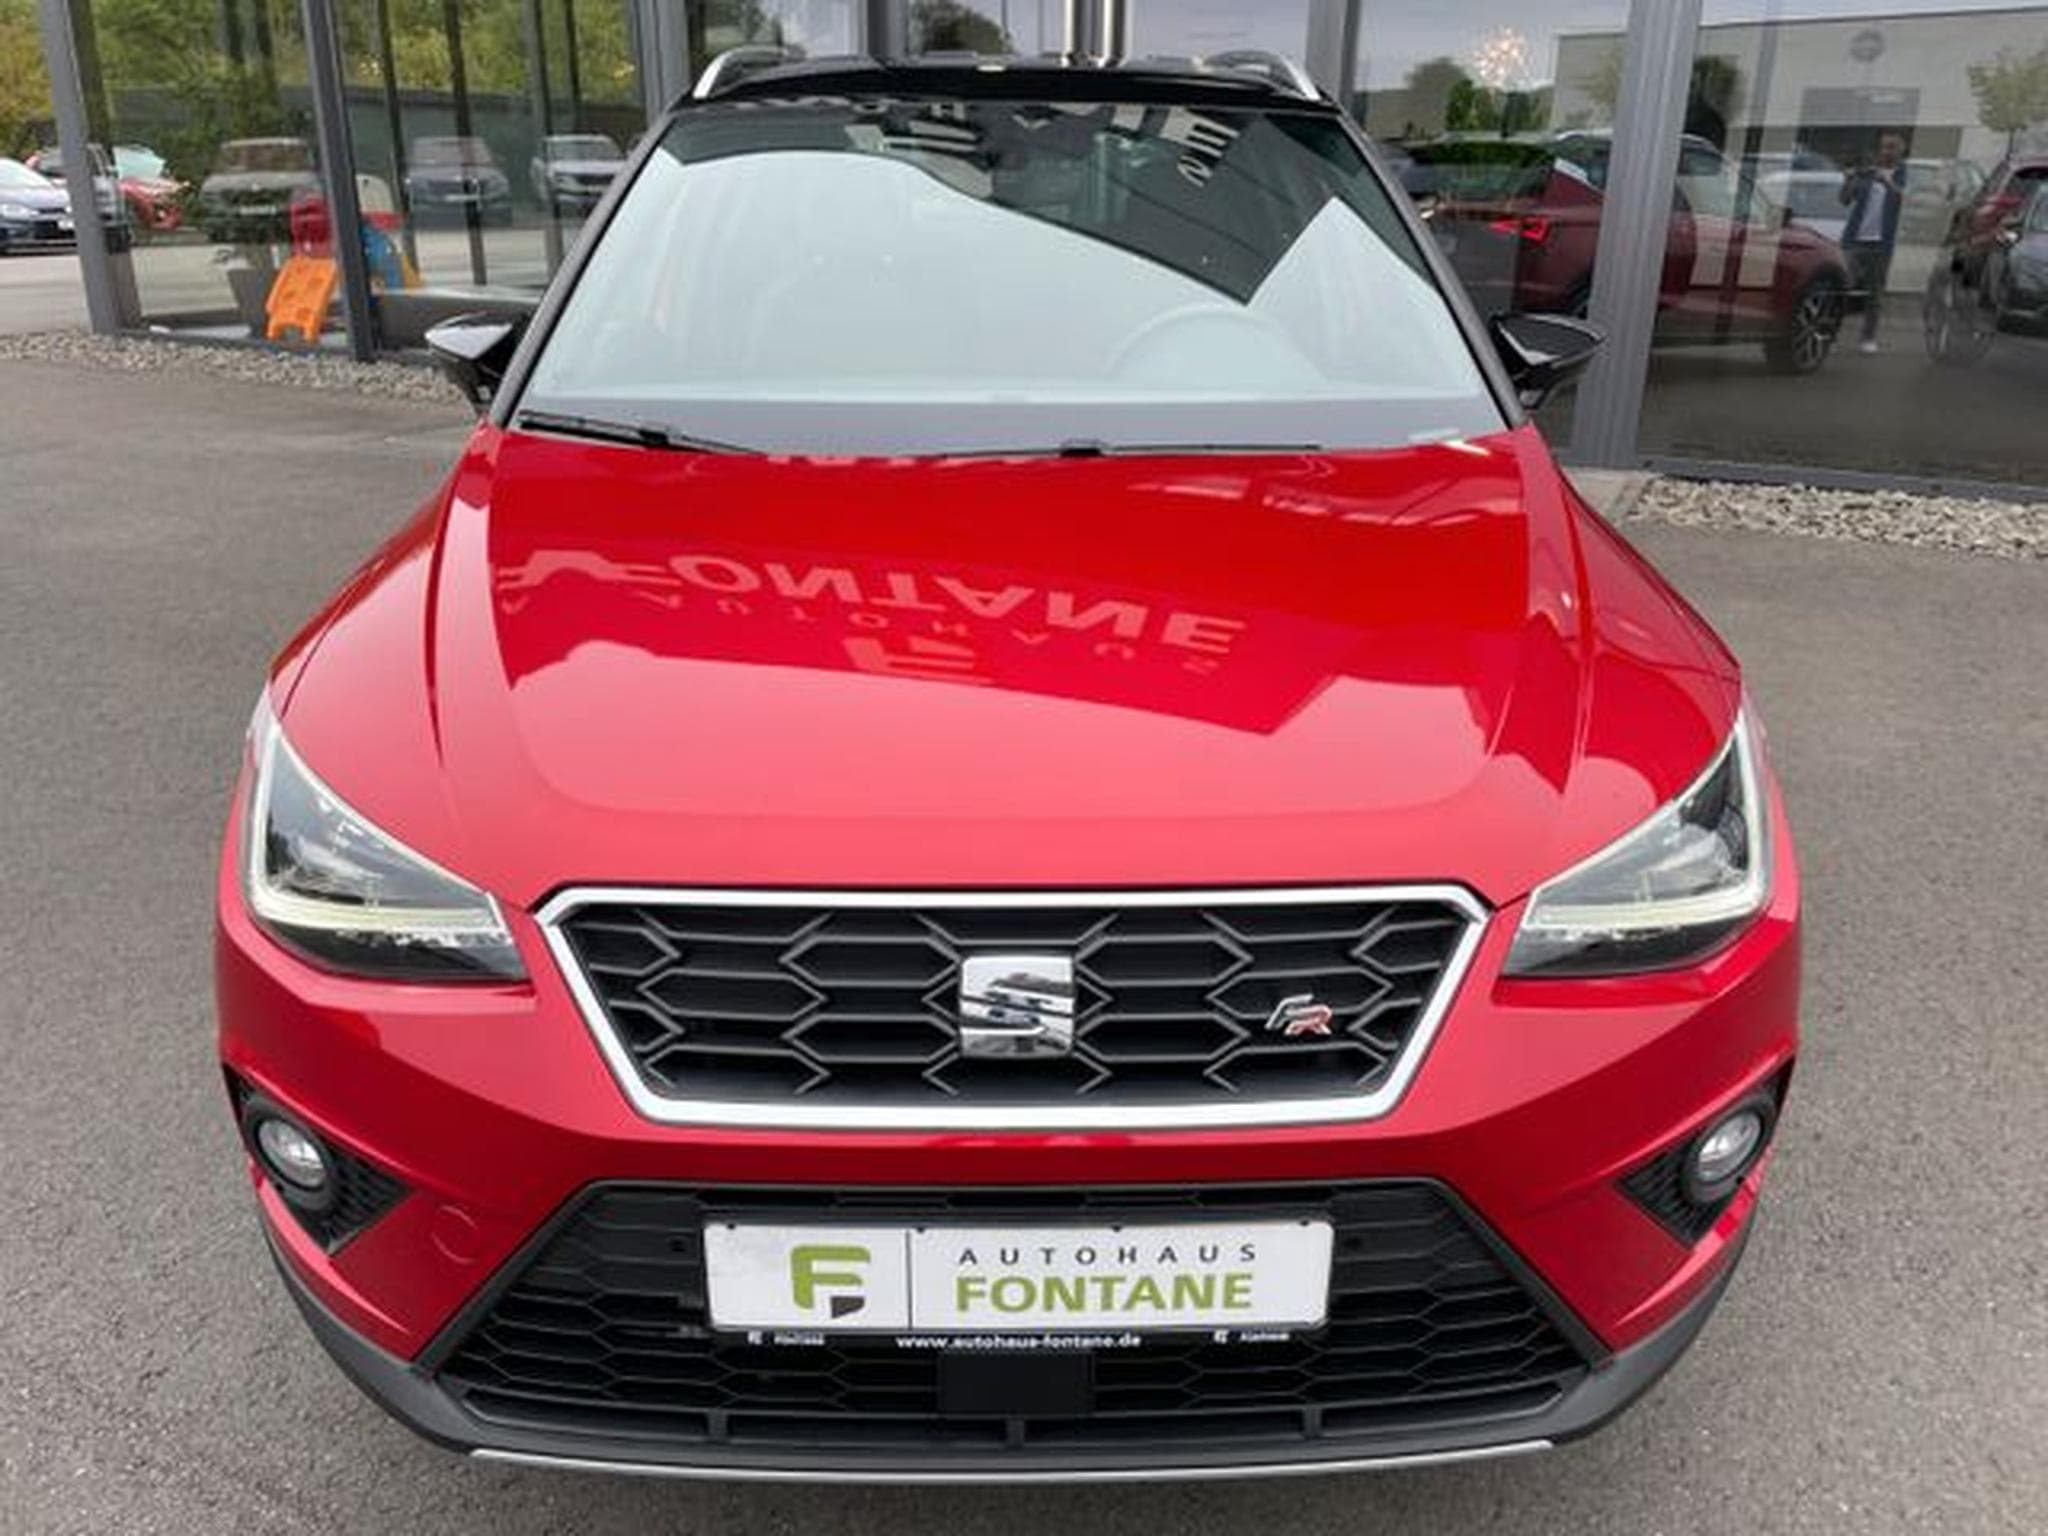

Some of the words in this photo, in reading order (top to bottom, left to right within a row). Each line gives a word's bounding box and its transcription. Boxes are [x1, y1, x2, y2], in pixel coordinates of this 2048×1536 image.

[1264, 993, 1333, 1035] FR
[957, 1243, 1257, 1267] AUTOHAUS
[954, 1272, 1255, 1313] FONTANE
[895, 1333, 1143, 1349] www.autohaus-fontane.de
